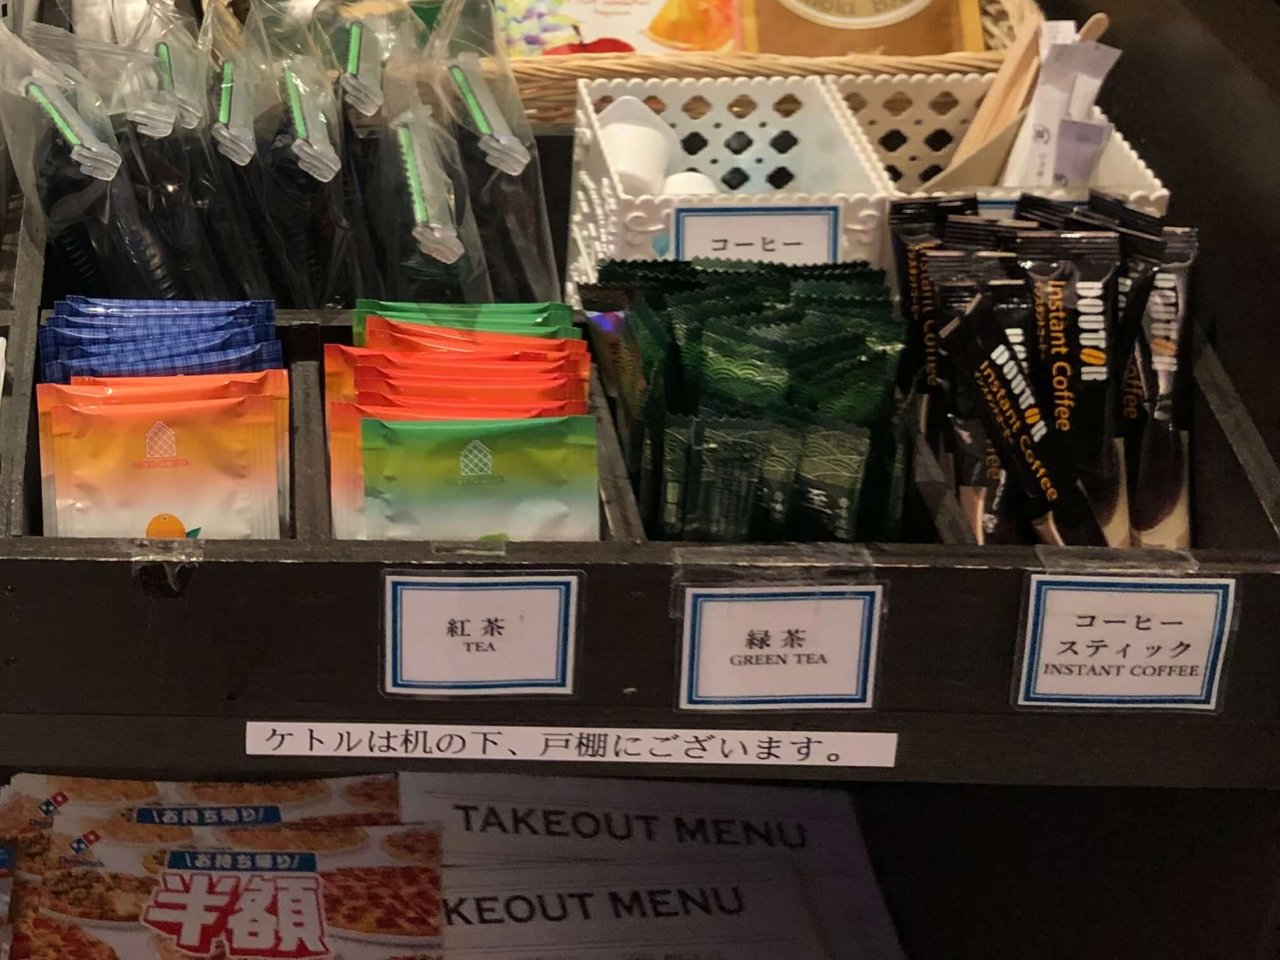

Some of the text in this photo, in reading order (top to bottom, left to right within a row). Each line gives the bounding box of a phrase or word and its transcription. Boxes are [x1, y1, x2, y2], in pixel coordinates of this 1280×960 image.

[710, 236, 803, 254] コーヒー
[1075, 281, 1109, 381] DOUTOR
[1048, 280, 1075, 431] Instant Coffee
[990, 343, 1048, 443] DOUTOR
[980, 360, 1022, 432] Instant
[1020, 434, 1058, 501] Coffee
[445, 617, 506, 638] 紅茶
[1076, 613, 1184, 631] コーヒー
[462, 641, 496, 654] TEA
[745, 628, 807, 650] 緑茶
[1055, 639, 1192, 659] スティック
[730, 652, 828, 668] GREEN TEA
[1043, 663, 1200, 678] INSTANT COFFEE
[264, 726, 842, 762] ケトルは机の下、戸棚にございます。
[453, 804, 807, 849] TAKEOUT MENU
[146, 874, 330, 957] 半額
[442, 886, 748, 926] KEOUT MENU
